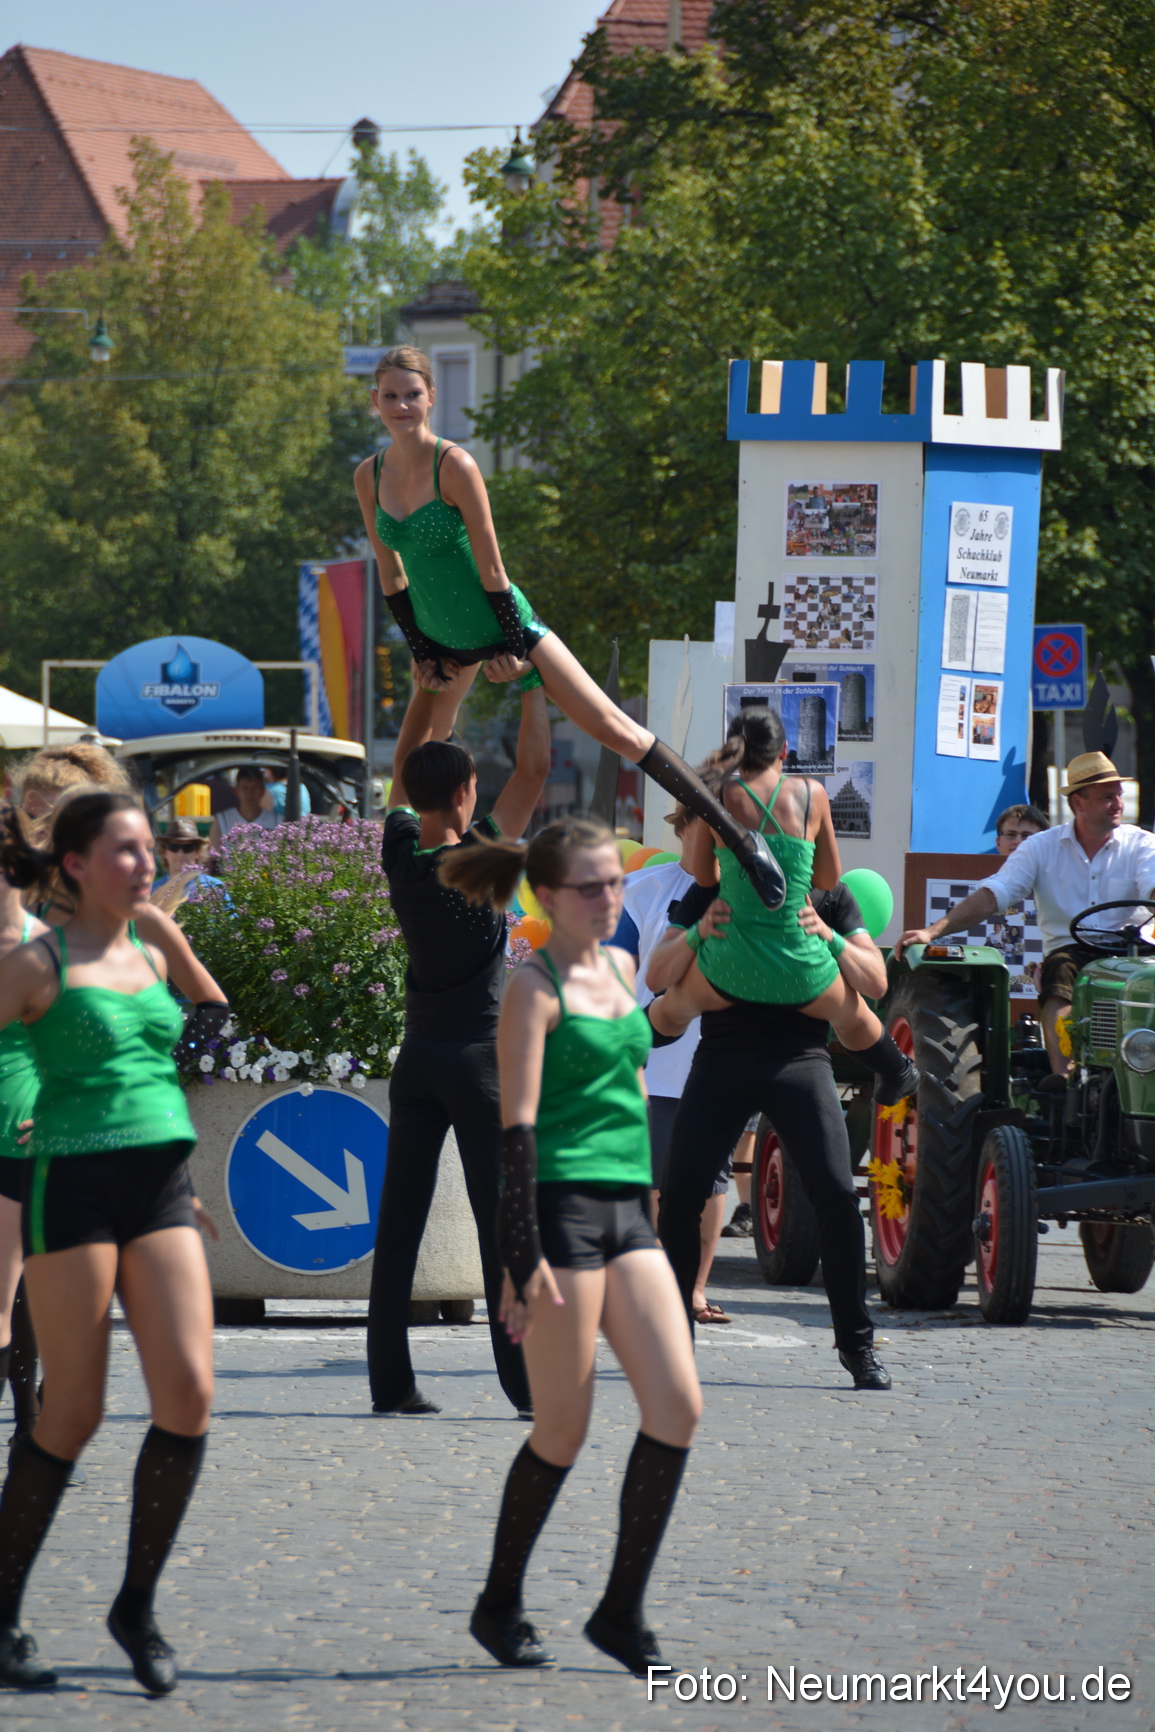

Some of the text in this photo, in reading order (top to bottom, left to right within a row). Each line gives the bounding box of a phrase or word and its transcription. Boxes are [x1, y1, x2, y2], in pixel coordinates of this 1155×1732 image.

[978, 510, 990, 522] 65
[969, 528, 993, 542] Jahre
[956, 546, 1003, 562] Schachklub
[959, 566, 999, 581] Neumarkt
[143, 683, 218, 697] FIBALON
[743, 687, 824, 695] Der Turm in der Schlacht
[1034, 682, 1082, 703] TAXI
